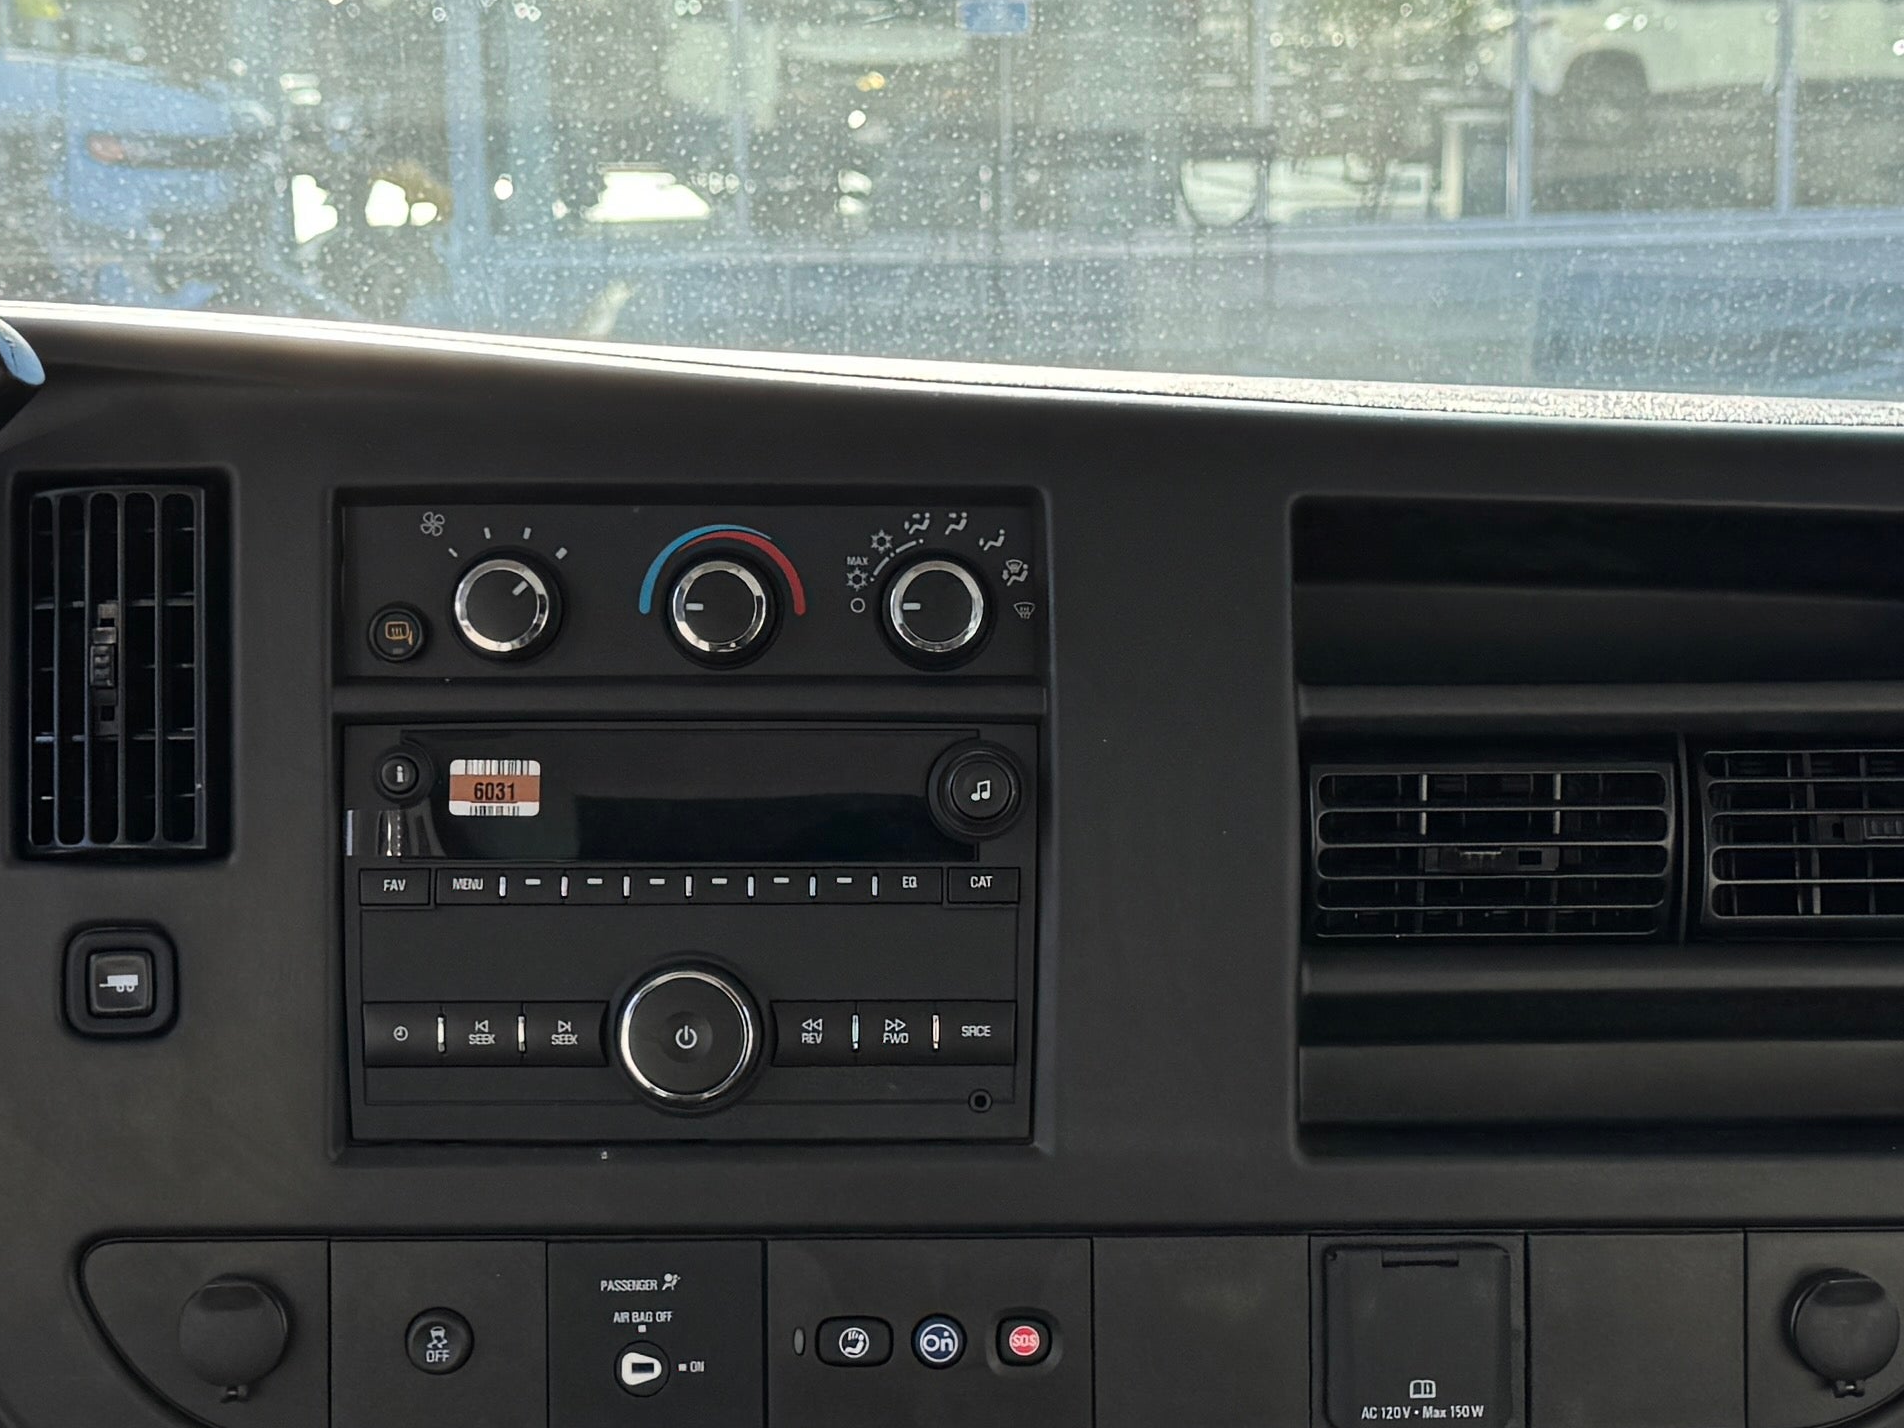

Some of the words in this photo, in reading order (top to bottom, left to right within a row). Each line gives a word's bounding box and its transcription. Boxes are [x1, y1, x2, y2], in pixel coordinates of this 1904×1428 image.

[847, 556, 868, 565] MAX
[474, 782, 515, 800] 6031
[384, 879, 406, 892] FAV
[453, 879, 484, 891] MENU
[903, 876, 917, 888] EQ
[971, 876, 992, 888] CAT
[962, 1025, 991, 1037] SRCE
[469, 1034, 495, 1044] SEEK
[551, 1034, 577, 1045] SEEK
[802, 1033, 822, 1044] REV
[883, 1033, 909, 1044] FWD
[600, 1280, 658, 1292] PASSENGER
[613, 1312, 630, 1323] AIR
[632, 1311, 653, 1322] BAG
[656, 1311, 672, 1322] OFF
[1012, 1334, 1038, 1348] SOS
[426, 1350, 450, 1362] OFF
[690, 1361, 704, 1372] ON
[1361, 1406, 1377, 1419] AC
[1422, 1406, 1446, 1418] Max
